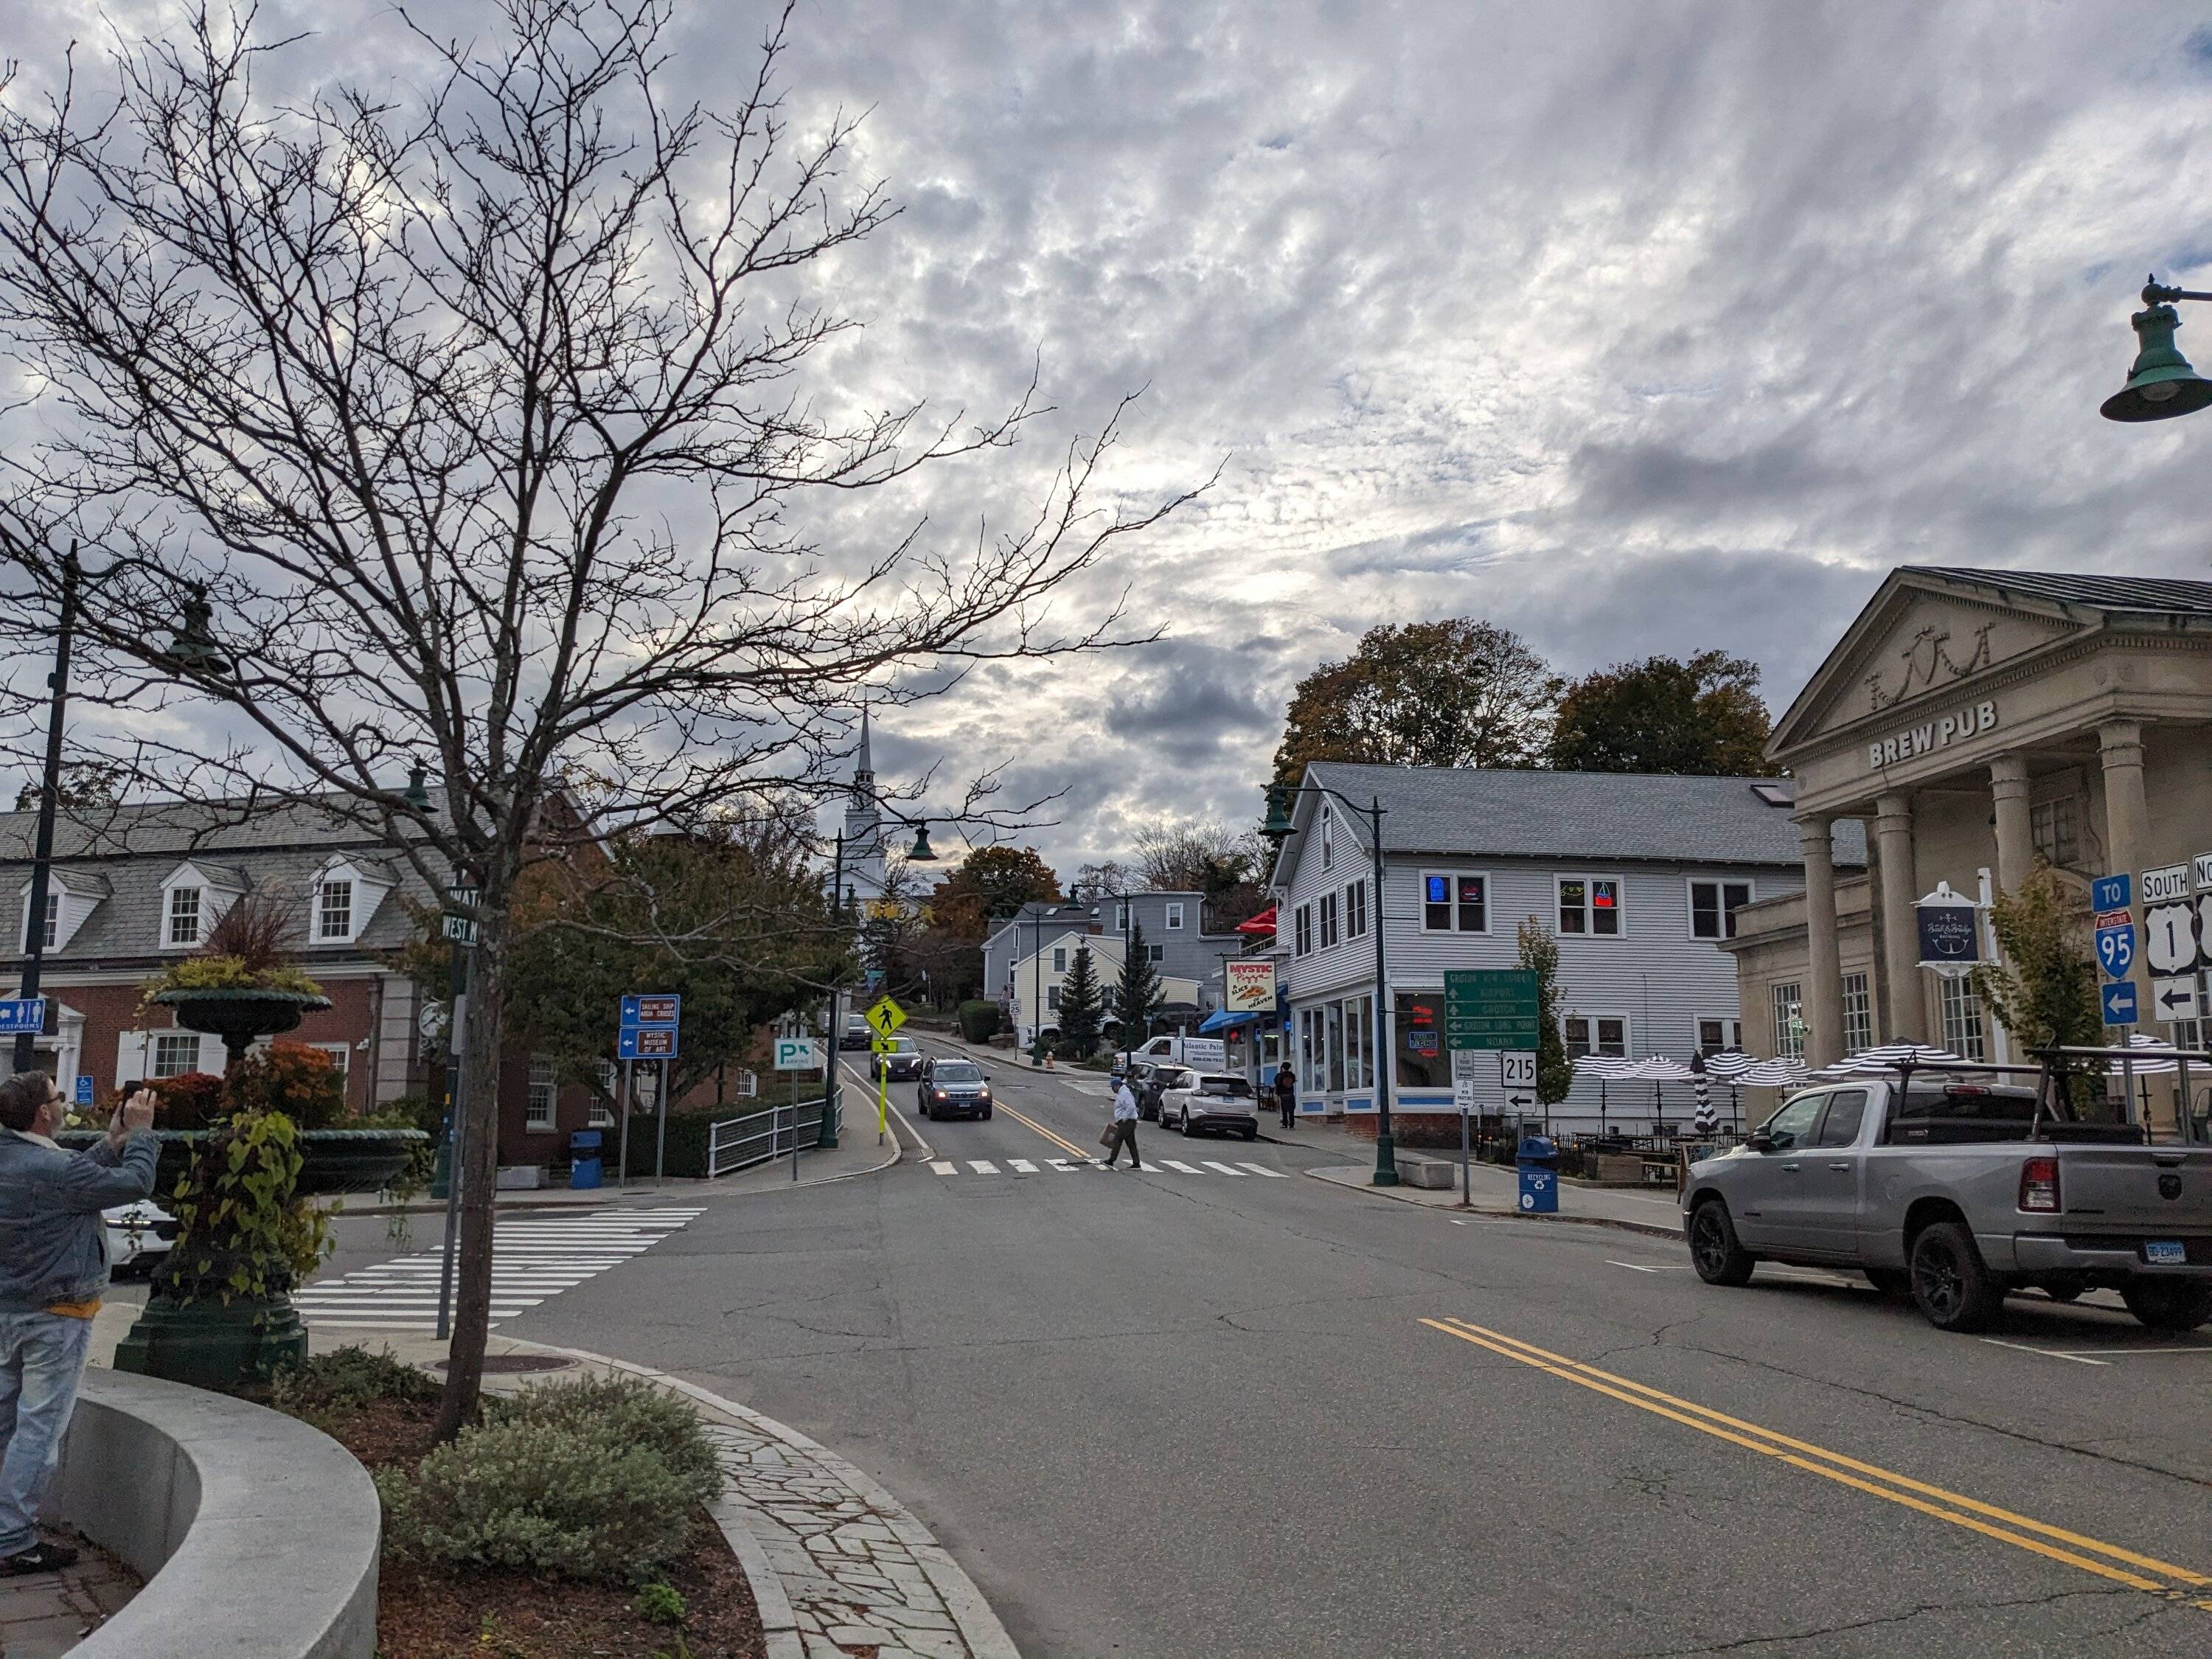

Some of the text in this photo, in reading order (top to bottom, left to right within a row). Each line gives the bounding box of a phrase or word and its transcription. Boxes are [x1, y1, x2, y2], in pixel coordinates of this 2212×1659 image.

[1868, 701, 1996, 768] BREW PUB
[2102, 883, 2121, 904] TO
[2143, 872, 2188, 897] SOUTH
[450, 890, 481, 908] WAT
[442, 915, 478, 942] WEST M
[2100, 914, 2128, 927] INTERSTATE
[2166, 921, 2175, 958] 1
[2101, 933, 2130, 967] 95
[1229, 964, 1273, 973] MYSTIC
[1234, 973, 1270, 984] Pizza
[1231, 985, 1248, 995] SLICE
[1248, 995, 1273, 1009] HEAVEN
[1482, 1005, 1515, 1014] GROTON
[1183, 1042, 1207, 1050] Atlantic
[1506, 1058, 1534, 1080] 215
